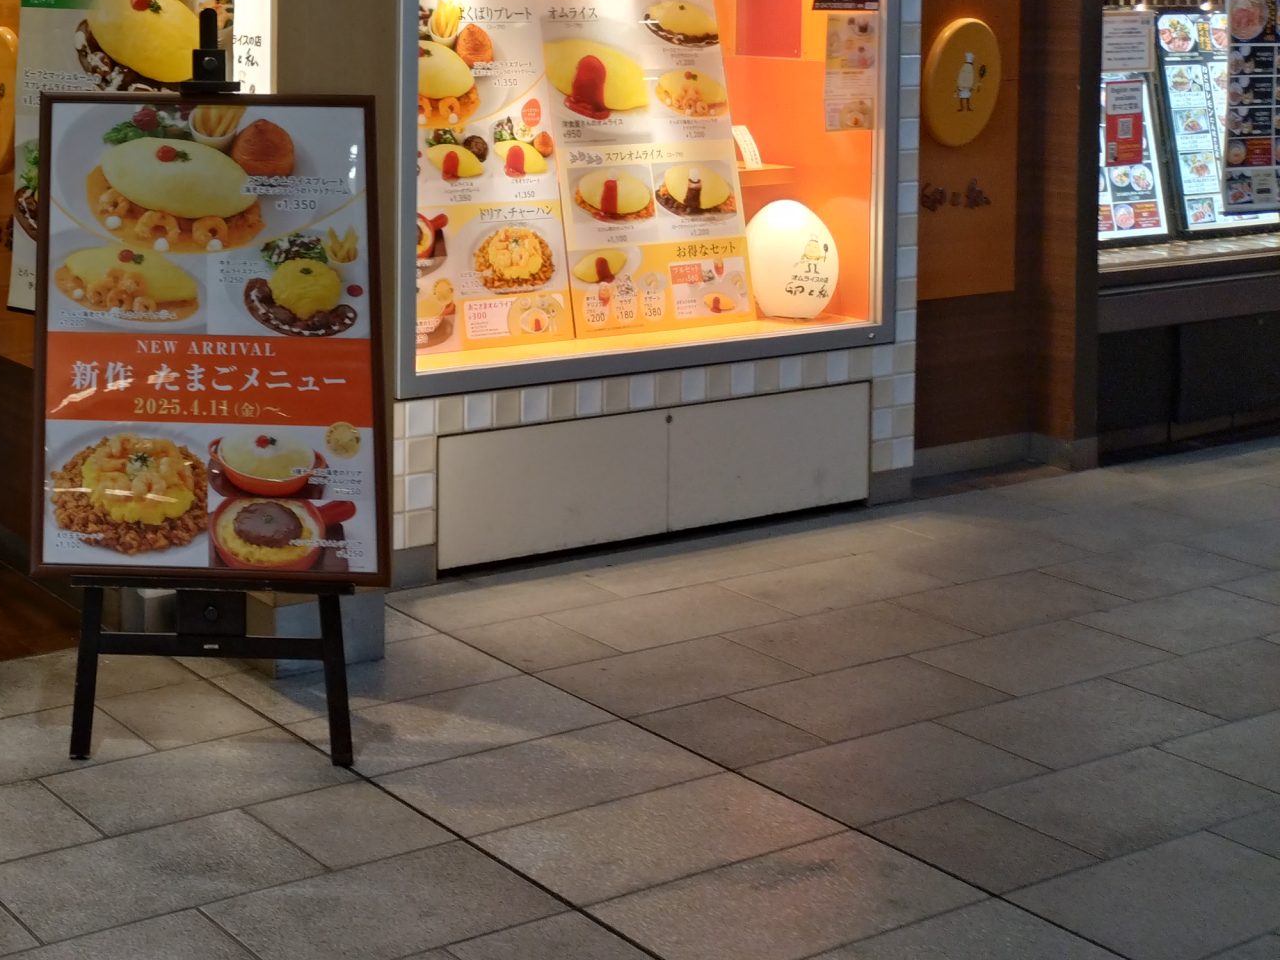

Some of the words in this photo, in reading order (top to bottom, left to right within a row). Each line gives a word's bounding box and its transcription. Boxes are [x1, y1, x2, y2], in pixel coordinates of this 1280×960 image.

[459, 7, 532, 21] よくばりプレート
[548, 7, 598, 19] オムライス
[605, 150, 663, 161] スフレオムライス
[277, 199, 317, 210] ¥1,350
[677, 242, 736, 258] お得なセット
[137, 339, 178, 354] NEW
[187, 341, 277, 357] ARRIVAL
[71, 360, 134, 390] 新作
[150, 363, 348, 392] たまごメニュー
